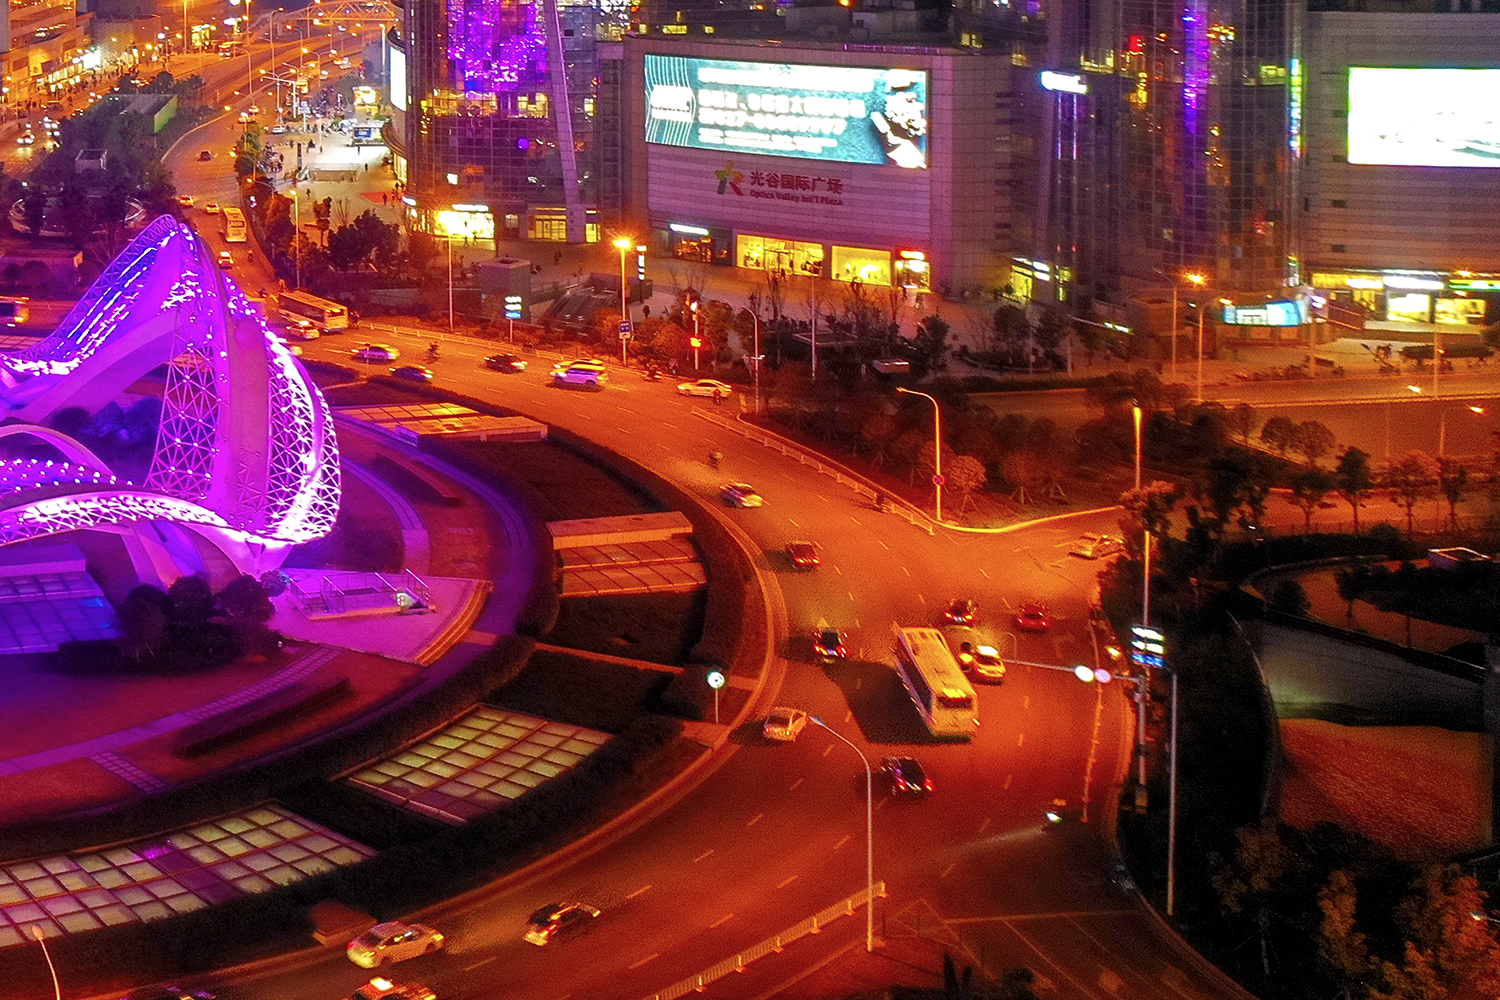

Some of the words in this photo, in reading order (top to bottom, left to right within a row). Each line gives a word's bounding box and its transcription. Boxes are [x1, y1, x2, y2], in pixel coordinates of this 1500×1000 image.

[750, 171, 843, 194] 光谷国际广场
[750, 189, 774, 199] Optics
[776, 192, 800, 202] Valley
[820, 196, 843, 205] Plaza
